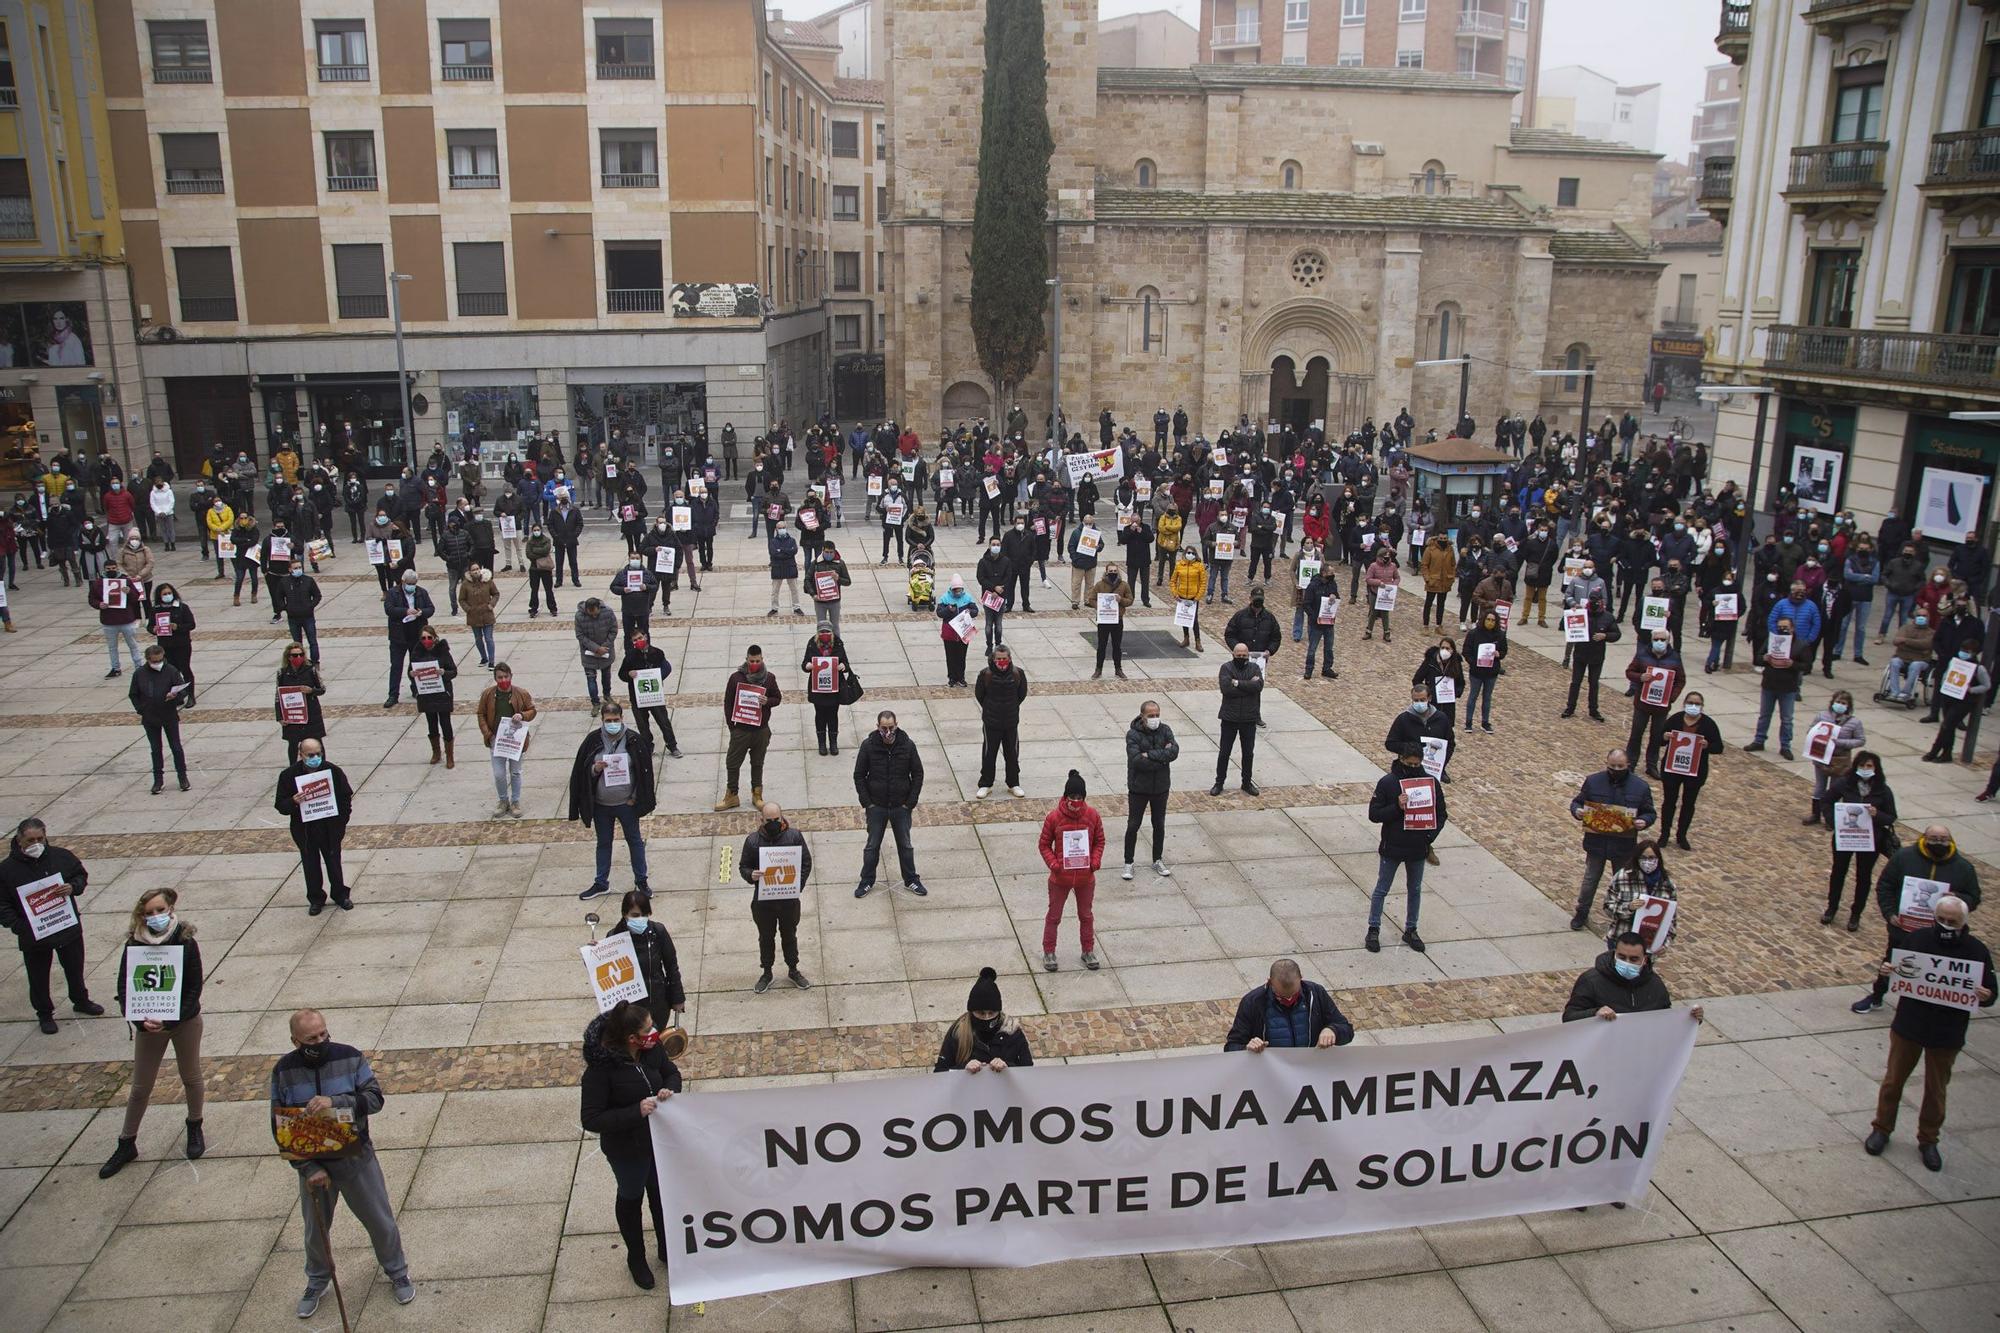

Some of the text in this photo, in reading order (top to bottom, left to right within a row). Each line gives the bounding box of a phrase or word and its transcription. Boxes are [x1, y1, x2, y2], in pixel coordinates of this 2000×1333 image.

[819, 677, 831, 685] NOS
[1649, 687, 1663, 698] NOS
[1674, 755, 1691, 766] NOS
[40, 910, 65, 923] Perdonen
[46, 914, 72, 928] molestias
[1930, 957, 1971, 974] Y MI
[1924, 972, 1975, 991] CAFÉ
[602, 982, 641, 1002] NOSOTROS
[603, 988, 643, 1008] EXISTIMOS
[1890, 980, 1977, 1007] ¿PA CUANDO?
[764, 1059, 1599, 1168] NO SOMOS UNA AMENAZA,
[682, 1117, 1651, 1254] ¡SOMOS PARTE DE LA SOLUCIÓN
